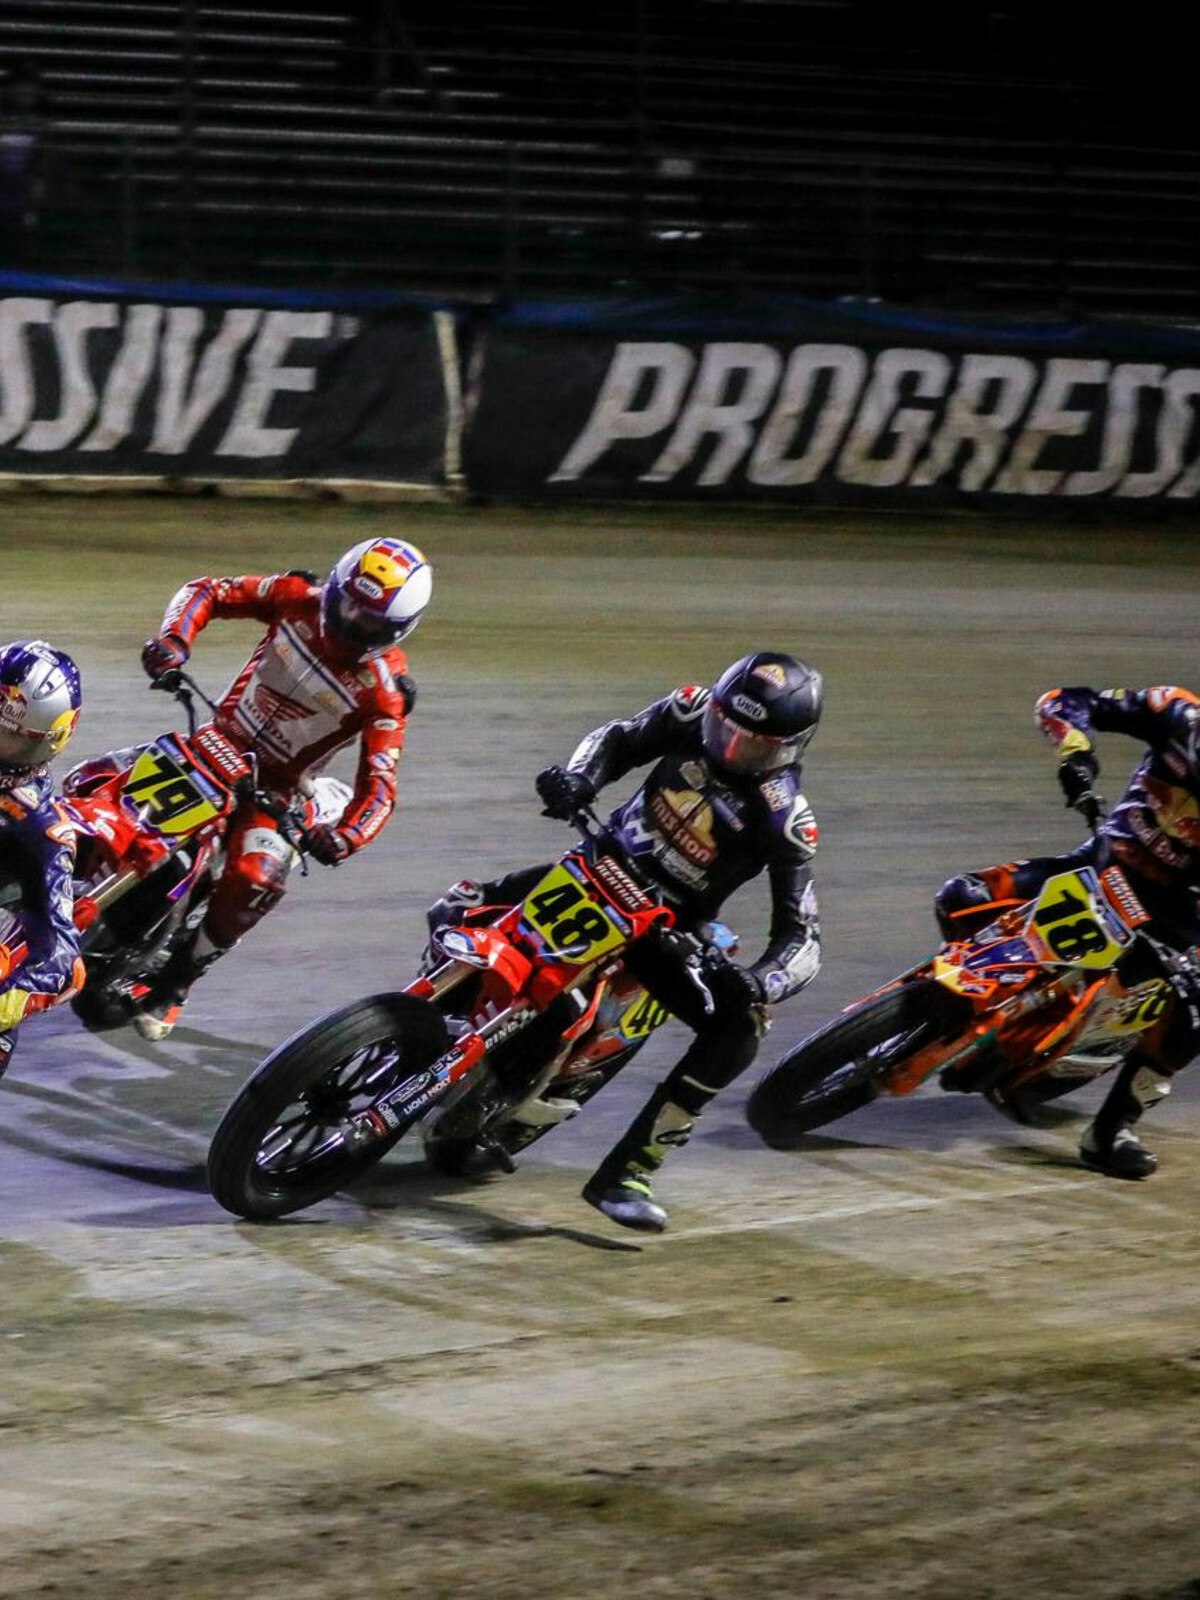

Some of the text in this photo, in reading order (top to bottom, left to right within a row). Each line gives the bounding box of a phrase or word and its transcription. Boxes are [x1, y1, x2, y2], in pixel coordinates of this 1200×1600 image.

[120, 755, 205, 826] 79
[529, 882, 610, 959] 48
[1035, 889, 1108, 962] 18
[426, 1075, 452, 1098] MOLY
